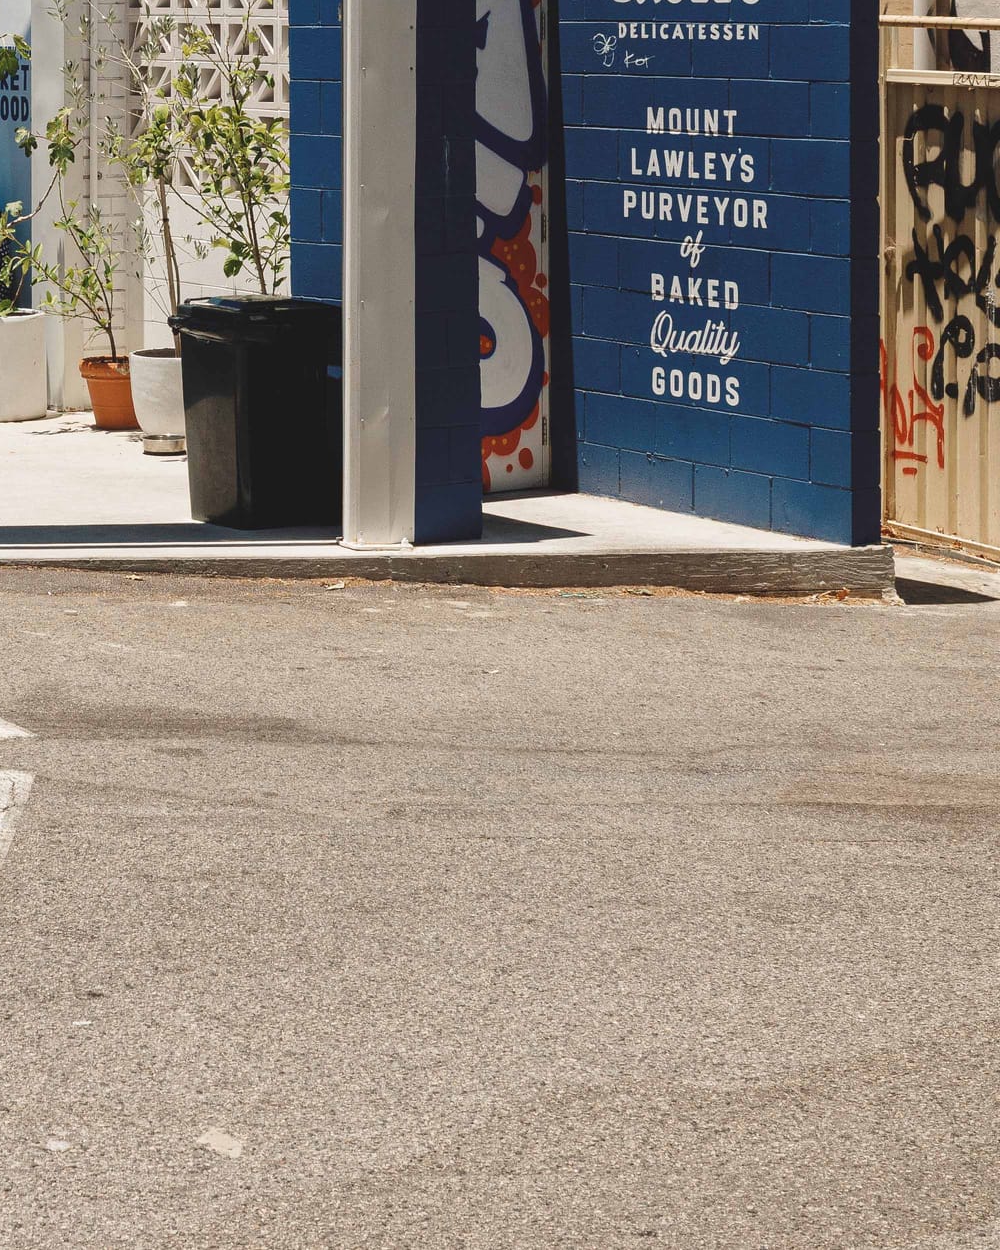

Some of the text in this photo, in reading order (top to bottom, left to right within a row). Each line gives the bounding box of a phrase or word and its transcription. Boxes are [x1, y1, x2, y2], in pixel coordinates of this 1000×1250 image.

[618, 22, 760, 41] DELICATESSEN
[646, 106, 738, 138] MOUNT
[631, 147, 755, 183] LAWLEY'S
[623, 190, 768, 229] PURVEYOR
[680, 230, 706, 268] of
[651, 272, 740, 311] BAKED
[650, 309, 741, 366] Quality
[652, 366, 740, 407] GOODS
